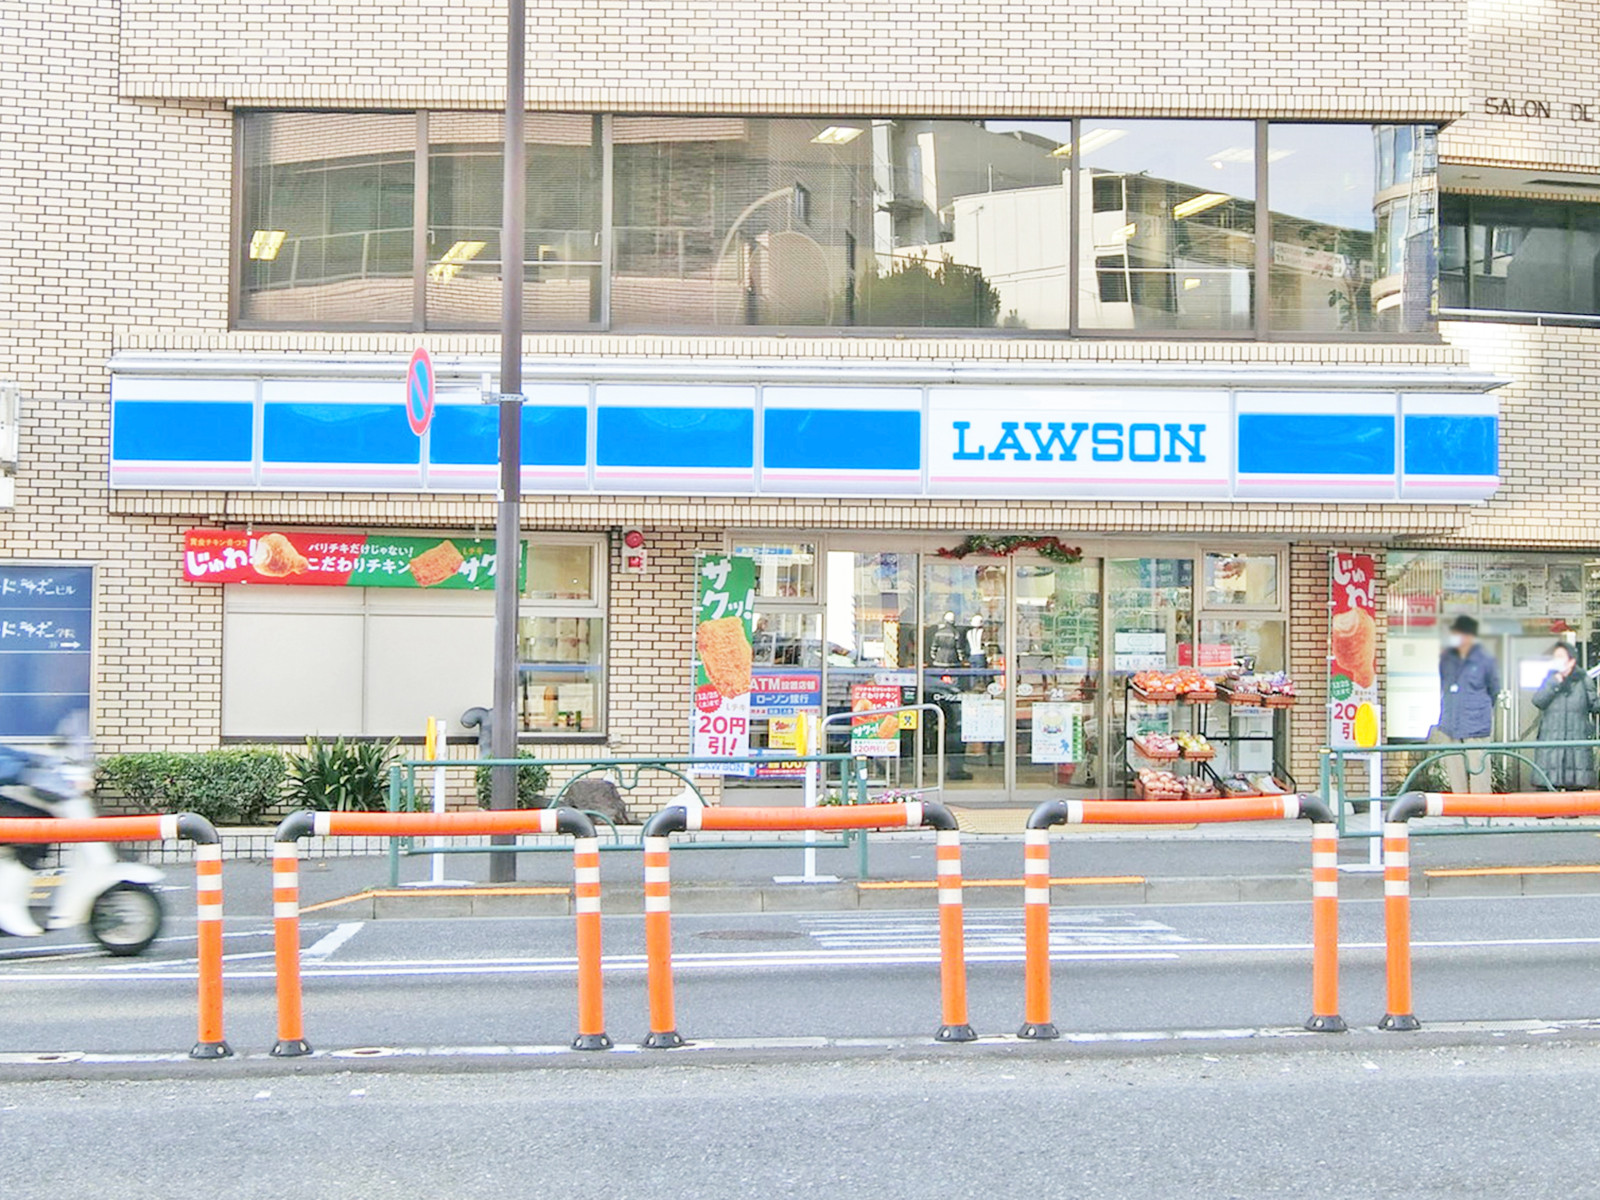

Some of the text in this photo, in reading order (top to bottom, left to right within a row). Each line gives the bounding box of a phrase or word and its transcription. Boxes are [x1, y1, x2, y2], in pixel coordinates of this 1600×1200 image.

[1484, 97, 1595, 122] SALON DE
[952, 421, 1207, 463] LAWSON
[306, 556, 412, 574] こだわりチキン
[701, 559, 755, 621] サクッ!
[756, 693, 809, 705] ローソン銀行
[698, 715, 746, 735] 20円
[708, 736, 738, 757] 引!
